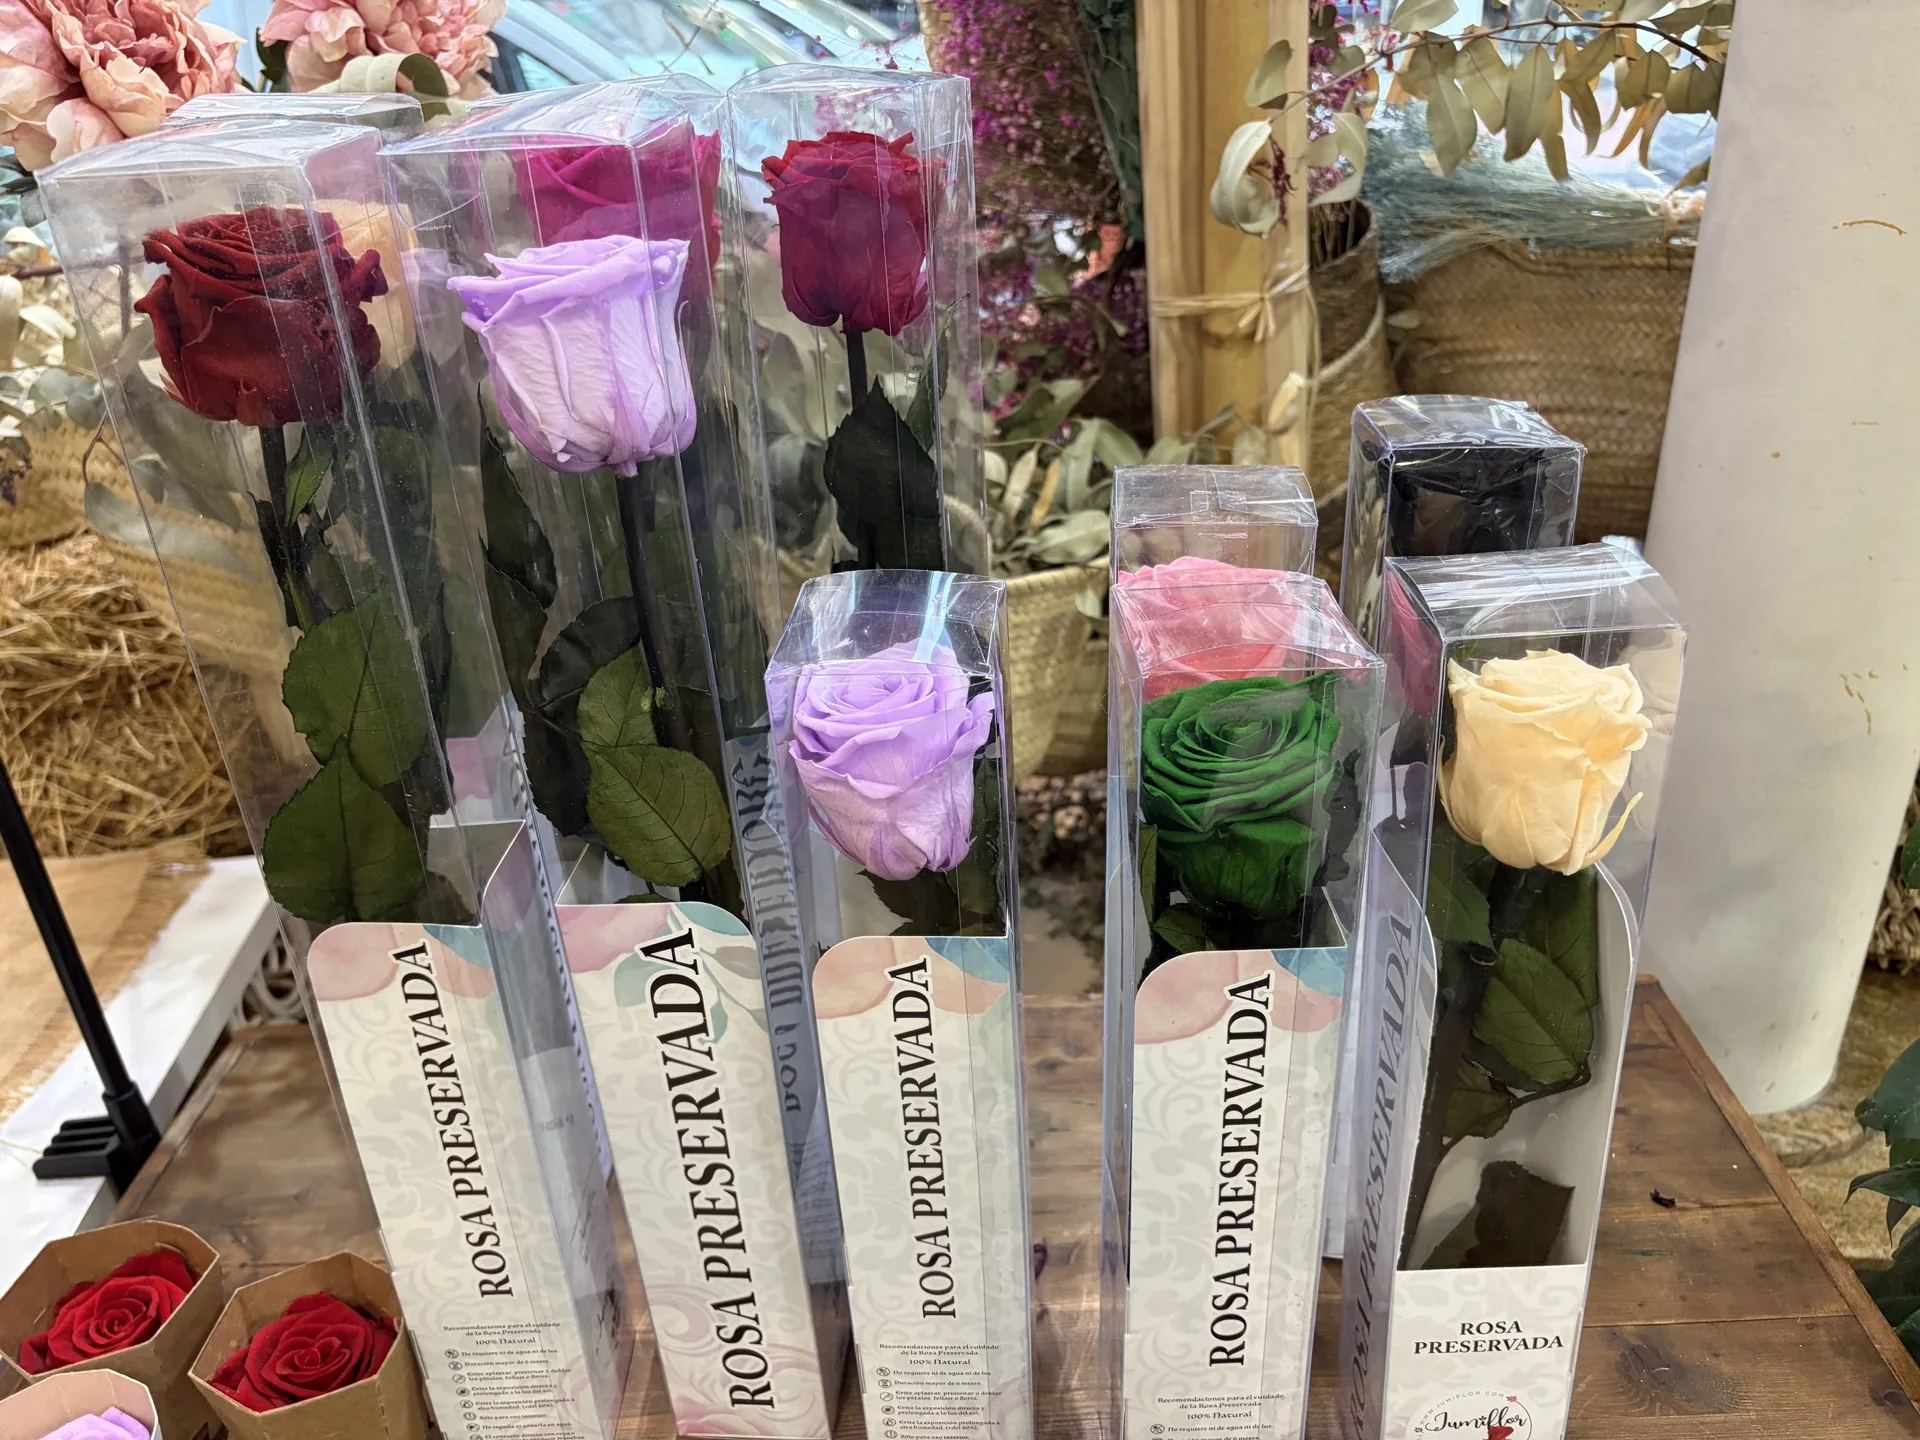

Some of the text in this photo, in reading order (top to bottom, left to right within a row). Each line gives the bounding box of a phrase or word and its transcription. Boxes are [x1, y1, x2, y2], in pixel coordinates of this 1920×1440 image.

[393, 942, 514, 1298] ROSA PRESERVADA
[639, 927, 775, 1408] ROSA PRESERVADA
[888, 958, 956, 1318] ROSA PRESERVADA
[1209, 974, 1271, 1367] ROSA PRESERVADA
[1359, 915, 1412, 1308] PRESERVADA
[1414, 1336, 1563, 1354] PRESERVADA
[1425, 1406, 1527, 1431] Jumiflor
[1460, 1320, 1522, 1335] ROSA
